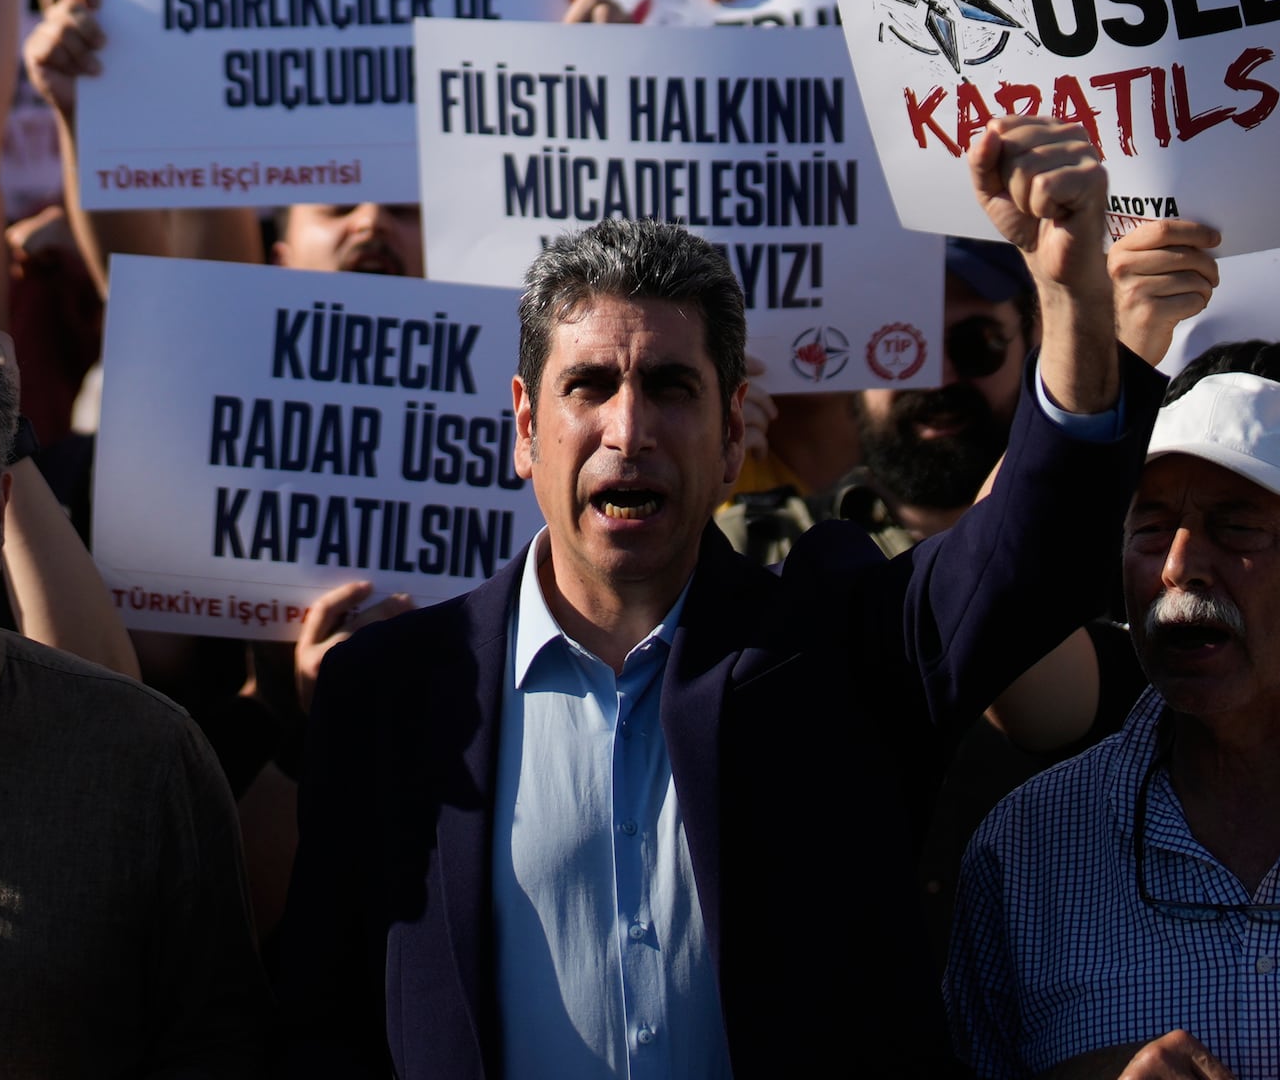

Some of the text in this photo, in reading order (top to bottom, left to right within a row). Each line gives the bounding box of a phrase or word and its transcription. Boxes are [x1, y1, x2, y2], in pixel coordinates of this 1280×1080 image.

[224, 45, 415, 112] SUÇLUDU
[439, 61, 845, 145] FİLİSTİN HALKININ
[96, 158, 362, 191] TÜRKİYE İŞÇİ PARTİSİ
[502, 146, 859, 227] MÜCADELESİNİN
[1106, 195, 1180, 218] ATO'YA
[271, 301, 482, 397] KÜRECİK
[883, 334, 913, 354] TİP
[208, 394, 382, 480] RADAR
[212, 486, 515, 580] KAPATILSIN!
[110, 587, 220, 618] TÜRKİYE
[226, 594, 280, 628] İŞÇİ
